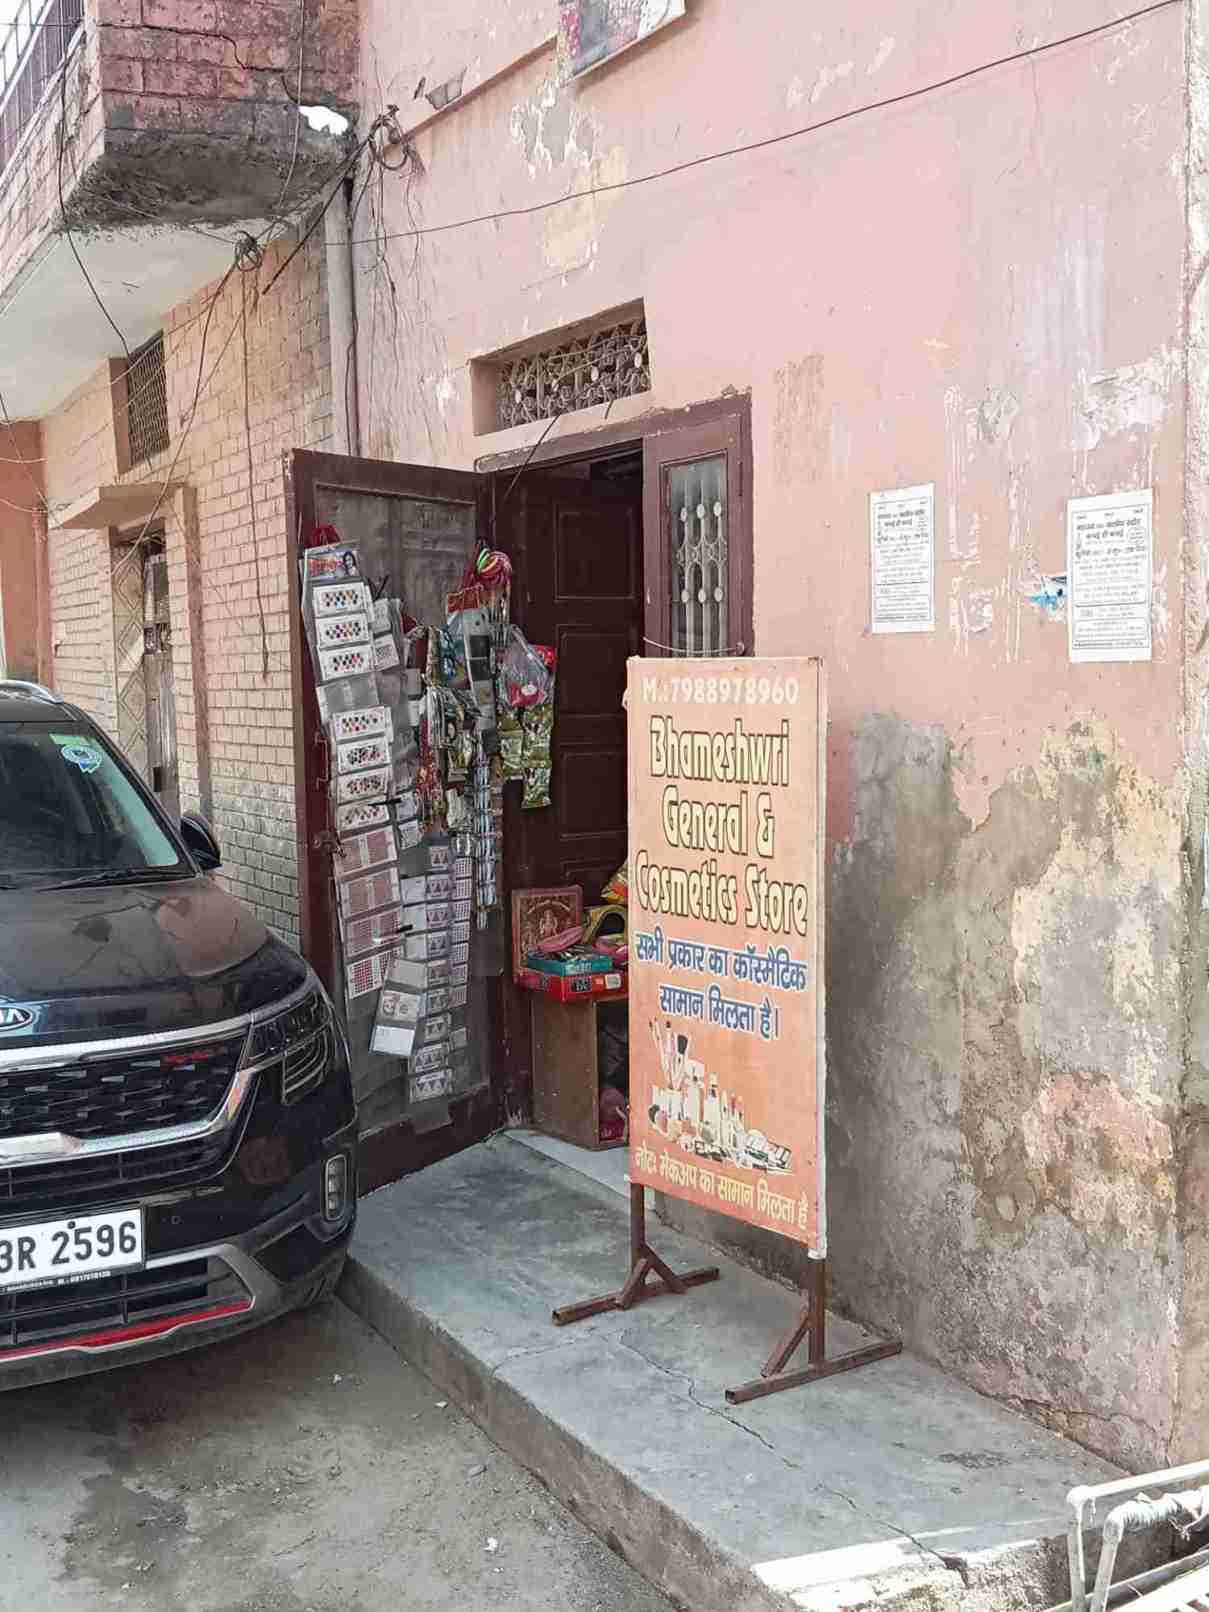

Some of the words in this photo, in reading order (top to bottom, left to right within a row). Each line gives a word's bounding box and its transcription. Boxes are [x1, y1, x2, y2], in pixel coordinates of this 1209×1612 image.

[650, 715, 790, 787] Bhameshwri
[662, 785, 749, 856] General
[756, 792, 774, 858] &
[636, 850, 738, 925] Cosmetics
[744, 863, 809, 936] Store
[636, 927, 664, 963] सभी
[667, 939, 705, 971] प्रकार
[708, 946, 728, 977] का
[660, 984, 704, 1021] सामान
[708, 985, 755, 1033] मिलता
[659, 1149, 697, 1190] मेकअप
[699, 1167, 716, 1197] का
[719, 1175, 753, 1208] सामान
[756, 1174, 796, 1225] मिलता
[798, 1191, 809, 1231] है
[51, 1221, 137, 1265] 2596
